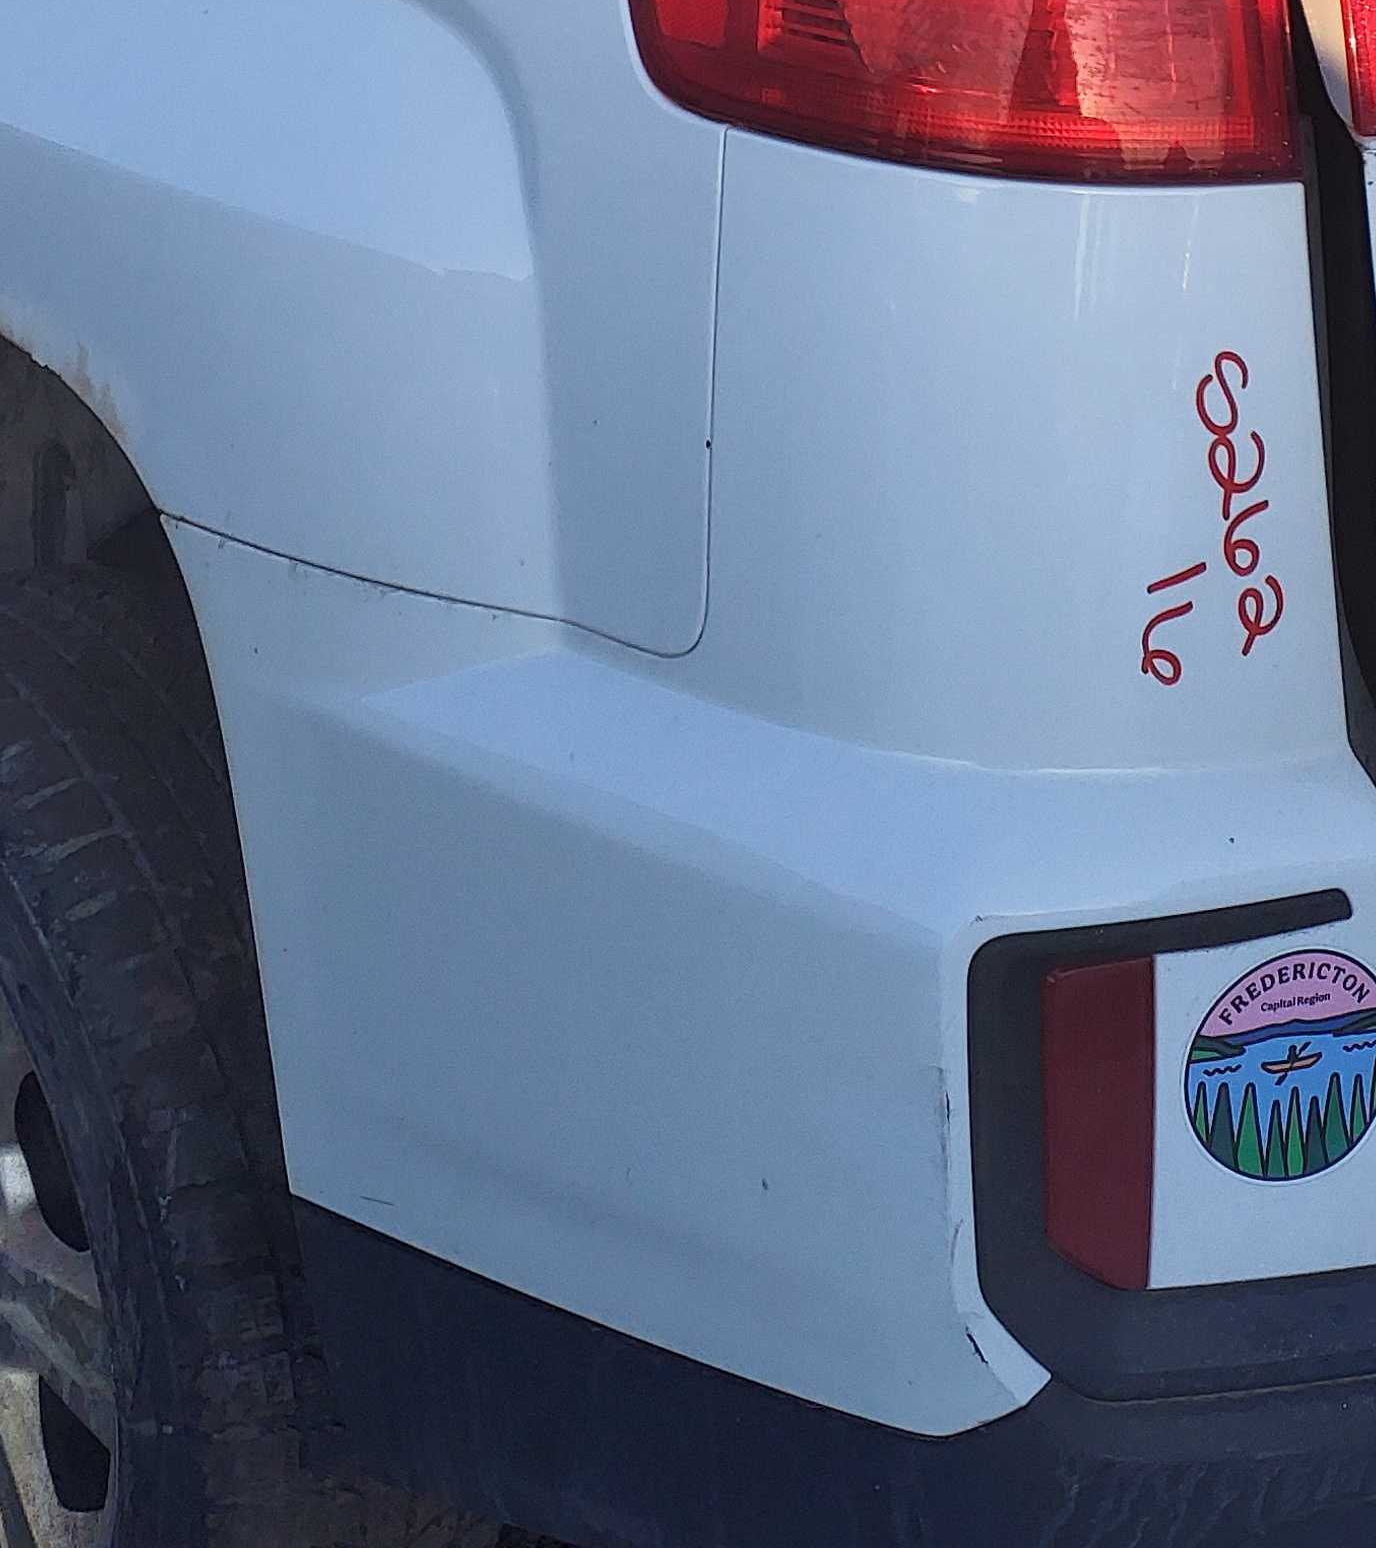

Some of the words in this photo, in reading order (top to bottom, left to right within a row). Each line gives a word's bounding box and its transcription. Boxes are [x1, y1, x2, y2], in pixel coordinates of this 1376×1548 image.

[1141, 562, 1207, 686] 16
[1218, 962, 1371, 1026] FREDERICTON
[1260, 996, 1296, 1013] Capital
[1297, 992, 1331, 1007] Region
